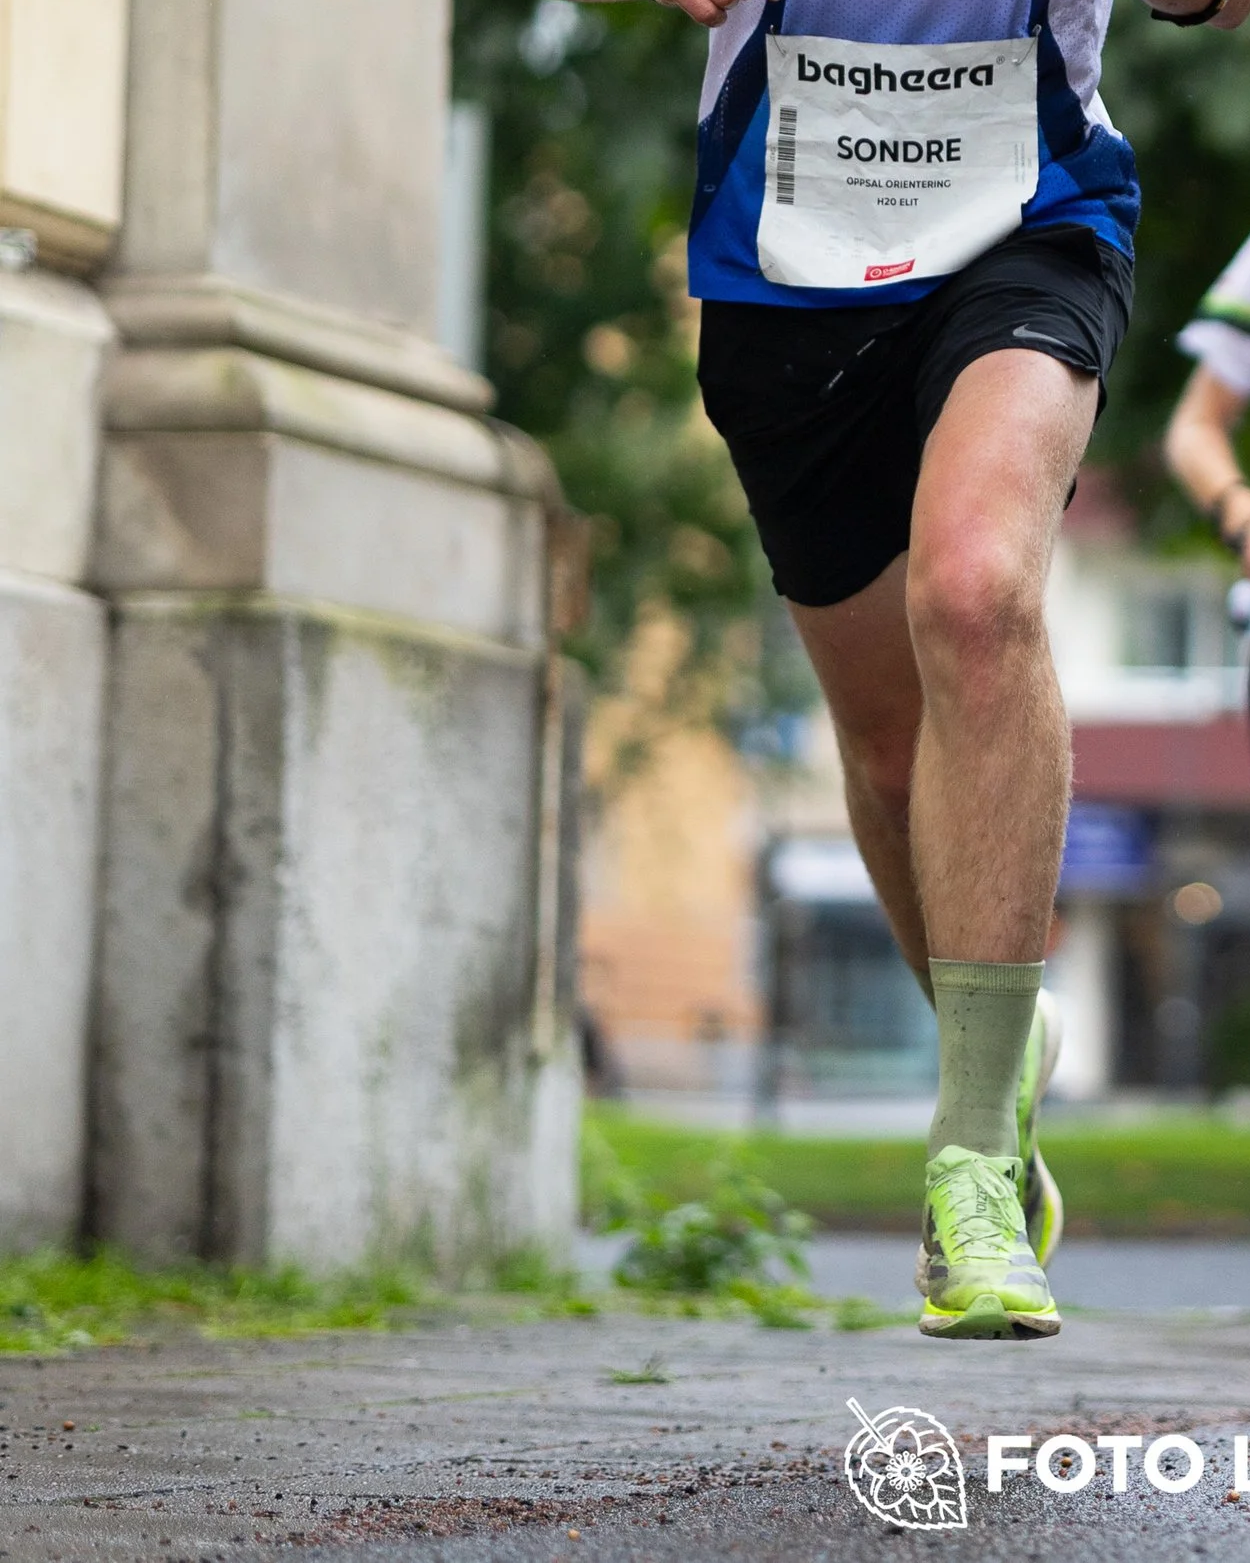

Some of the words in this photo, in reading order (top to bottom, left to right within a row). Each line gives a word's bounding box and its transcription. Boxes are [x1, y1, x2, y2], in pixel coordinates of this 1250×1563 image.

[797, 53, 994, 95] bagheera
[837, 135, 962, 164] SONDRE
[846, 176, 883, 189] OPPSAL
[885, 179, 952, 189] ORIENTERING
[877, 197, 897, 206] H20
[899, 198, 919, 207] ELIT
